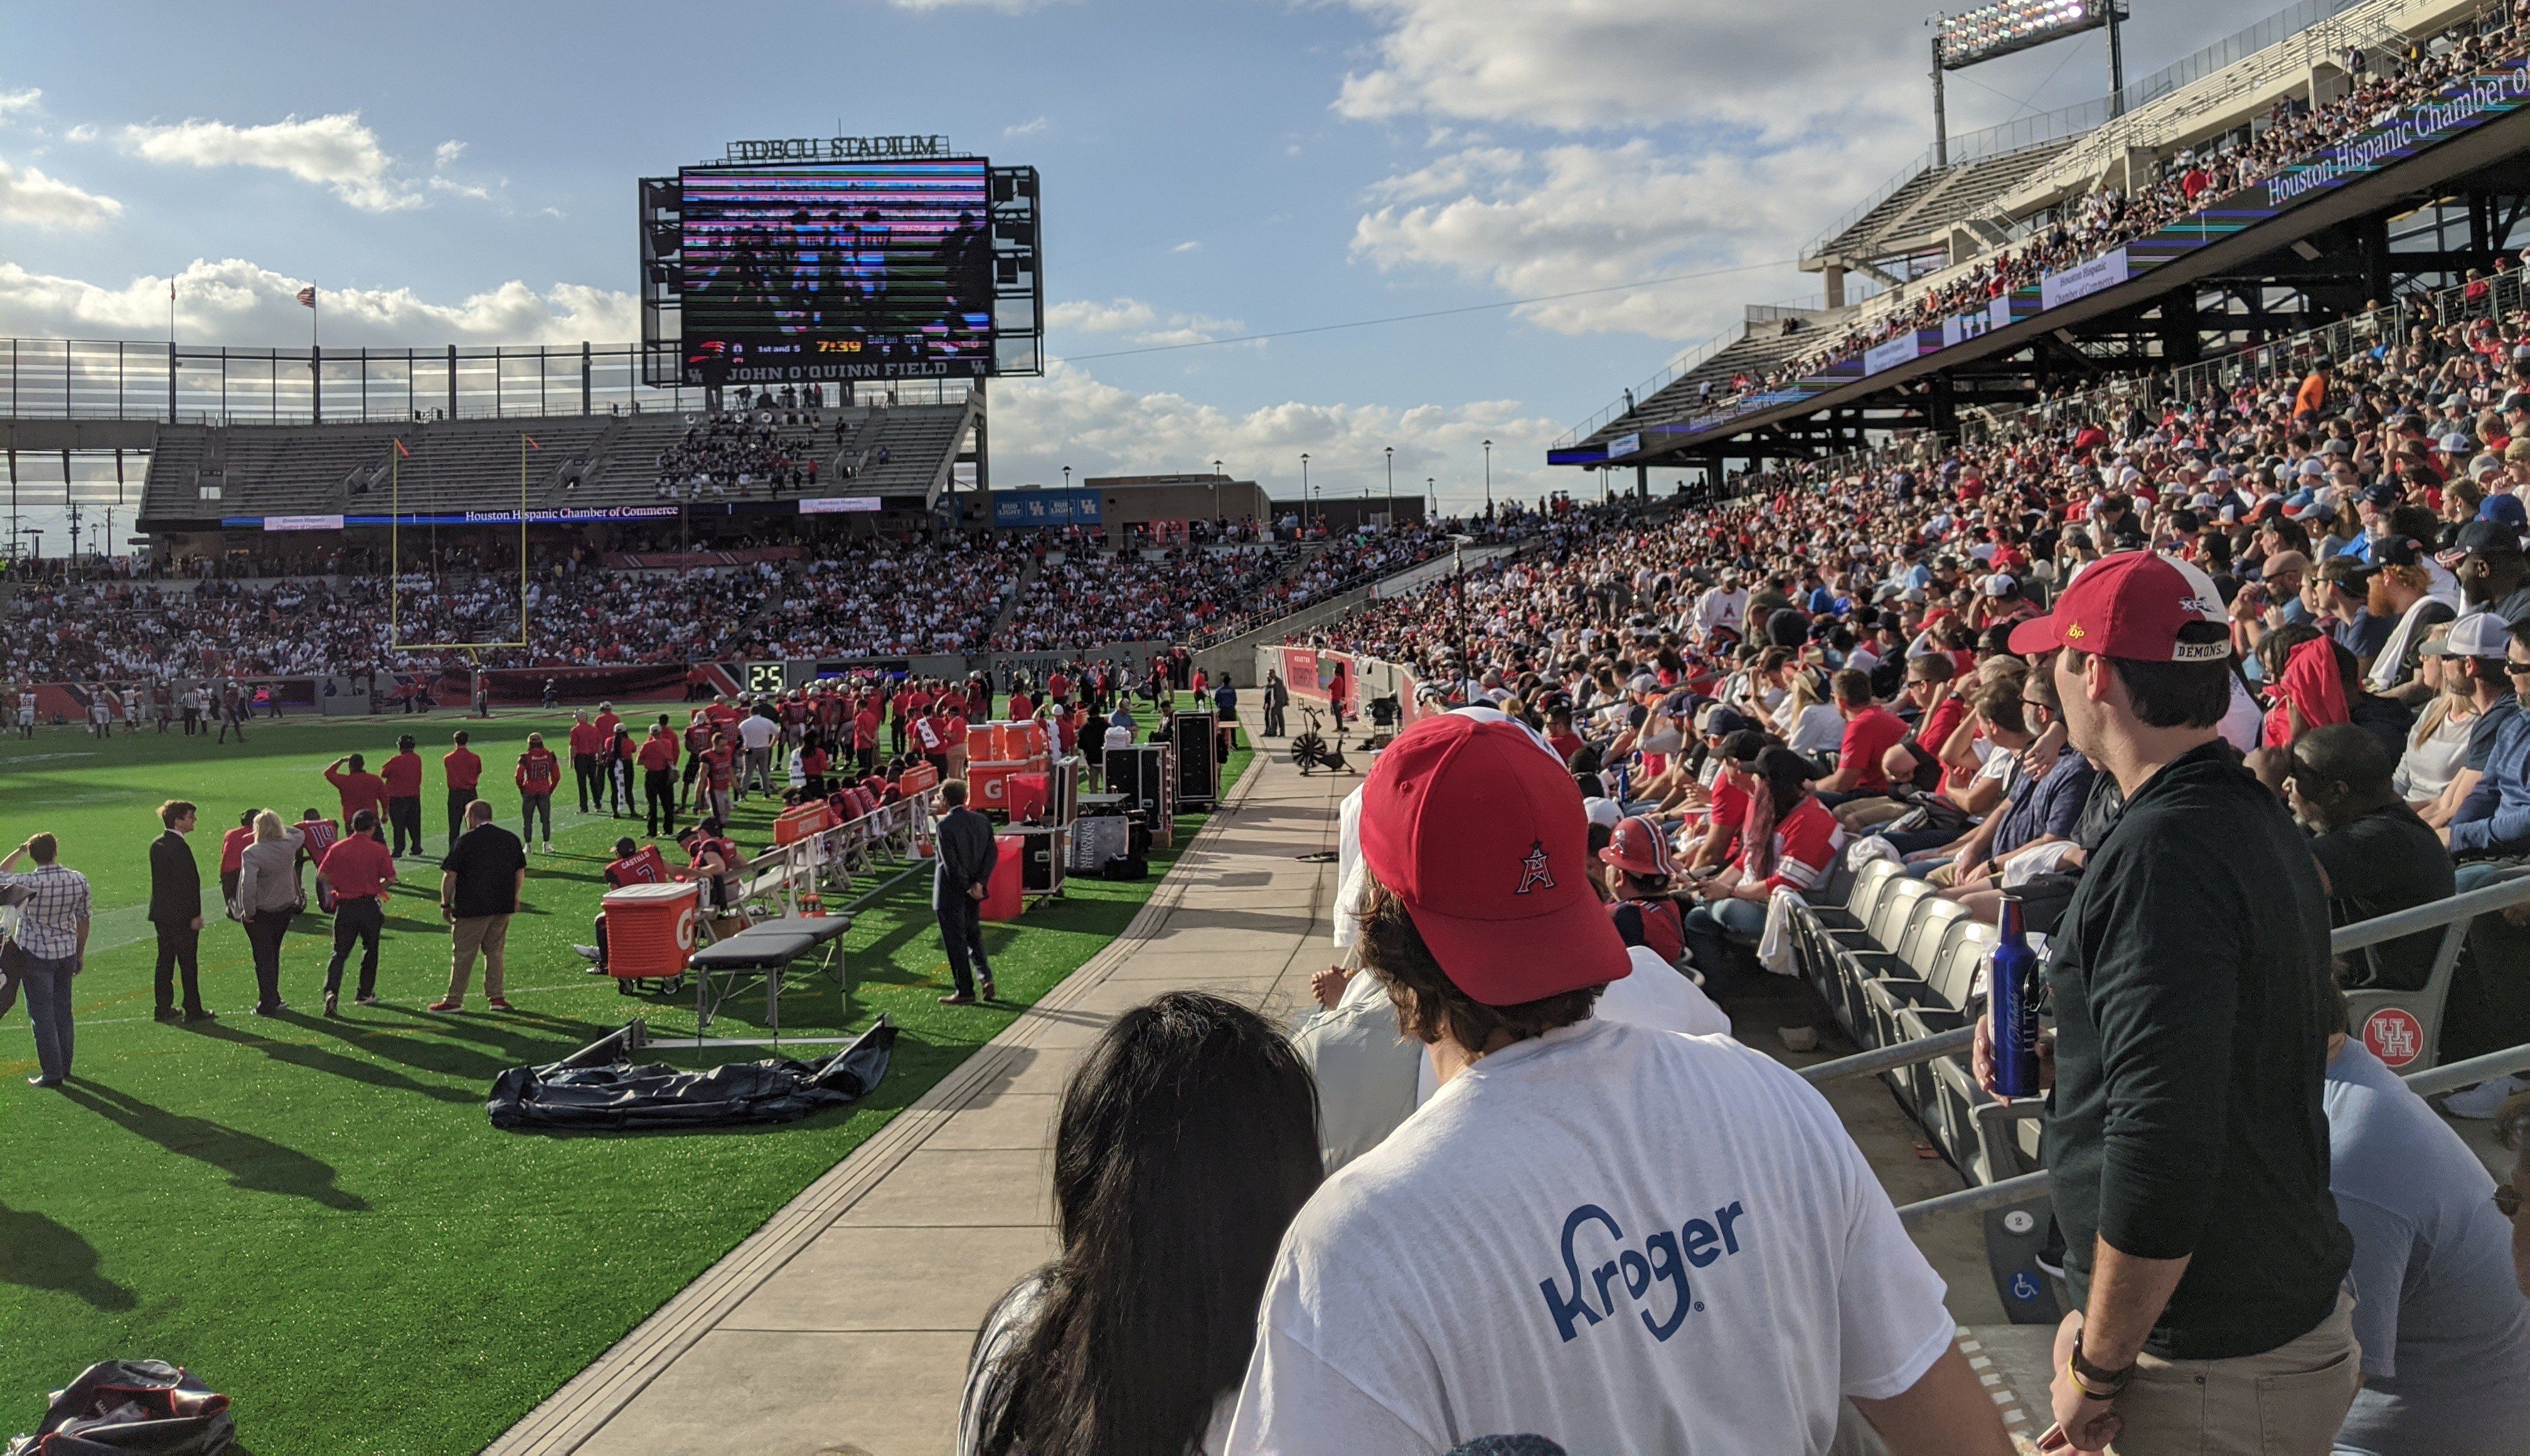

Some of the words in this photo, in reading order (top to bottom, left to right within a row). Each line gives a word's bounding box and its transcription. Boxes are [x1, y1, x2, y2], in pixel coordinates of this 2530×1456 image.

[736, 138, 819, 160] TDECU
[831, 135, 939, 157] STADIUM
[2267, 158, 2334, 206] Houston
[2336, 117, 2412, 176] Hispanic
[2416, 75, 2511, 137] Chamber
[816, 339, 862, 353] 7:39
[726, 367, 784, 381] JOHN
[789, 363, 878, 380] O'QUINN
[884, 361, 948, 377] FIELD
[465, 511, 510, 522] Houston
[511, 507, 558, 522] Hspanic
[560, 507, 607, 519] Chamber
[609, 506, 622, 518] of
[622, 506, 679, 517] Commerce
[2177, 644, 2222, 657] DEMONS
[750, 665, 783, 692] 25
[985, 779, 1003, 799] G
[621, 851, 650, 869] CASTILLO
[636, 863, 657, 884] 7
[676, 907, 692, 950] G
[2372, 1018, 2414, 1056] UH
[2014, 1216, 2024, 1226] 2
[1539, 1200, 1744, 1343] Kroger
